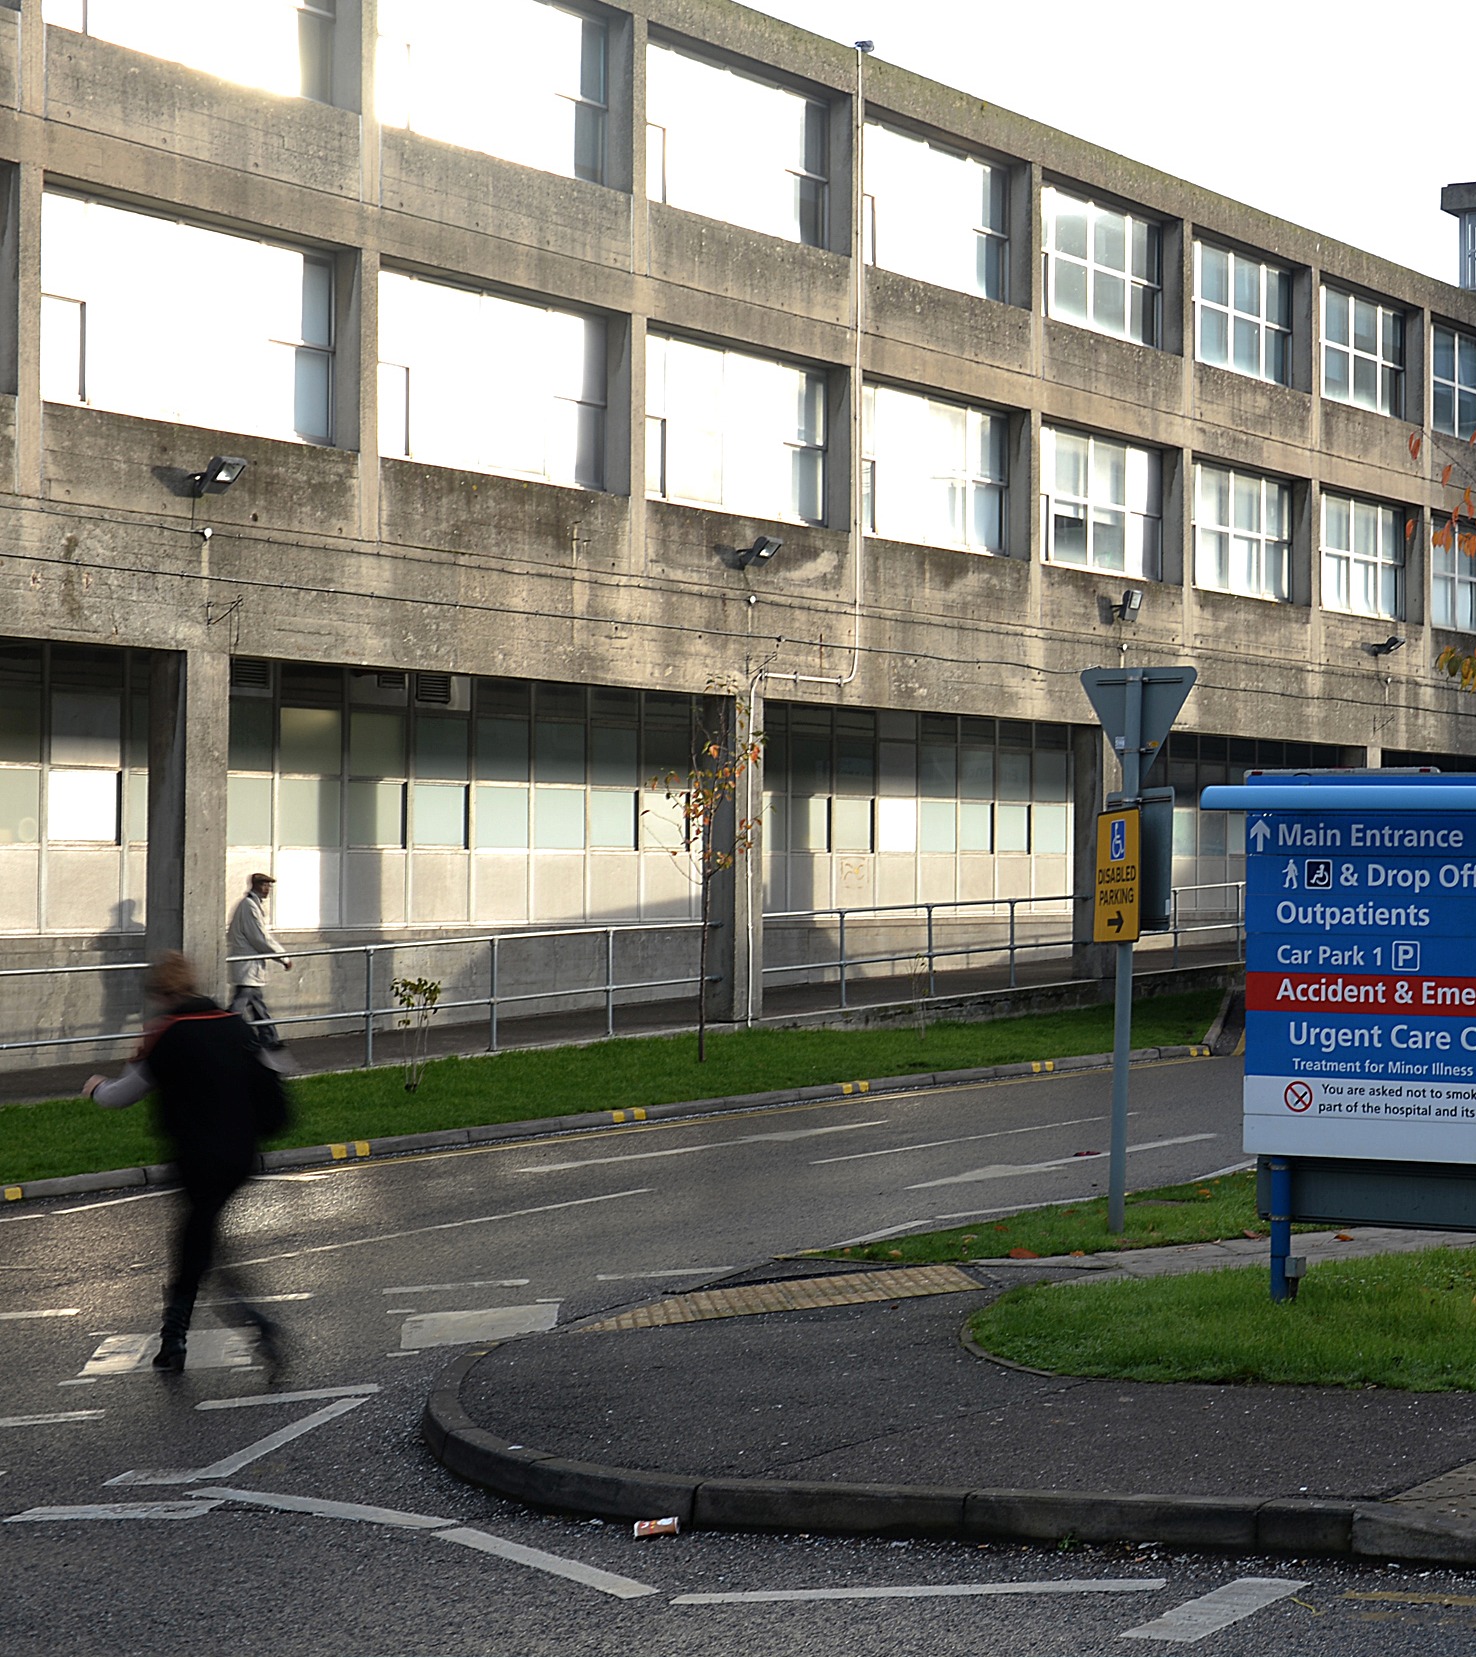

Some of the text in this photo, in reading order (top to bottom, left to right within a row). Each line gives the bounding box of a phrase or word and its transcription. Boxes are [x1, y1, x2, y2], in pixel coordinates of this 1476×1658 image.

[1279, 823, 1463, 847] Main Entrance
[1098, 865, 1136, 885] DISABLED
[1340, 864, 1358, 886] &
[1368, 864, 1430, 893] Drop
[1099, 888, 1134, 906] PARKING
[1277, 901, 1429, 930] Outpatients
[1277, 945, 1312, 964] Car
[1319, 945, 1364, 965] Park
[1373, 947, 1381, 965] 1
[1276, 978, 1386, 1003] Accident
[1395, 981, 1412, 1003] &
[1290, 1022, 1382, 1052] Urgent
[1391, 1025, 1450, 1049] Care
[1293, 1058, 1360, 1072] Treatment
[1365, 1060, 1384, 1072] for
[1388, 1061, 1428, 1074] Minor
[1432, 1063, 1473, 1076] Illness
[1322, 1084, 1342, 1094] You
[1347, 1087, 1365, 1095] are
[1369, 1086, 1401, 1098] asked
[1406, 1087, 1425, 1098] not
[1430, 1089, 1442, 1098] to
[1319, 1103, 1342, 1114] part
[1346, 1102, 1358, 1112] of
[1362, 1102, 1380, 1114] the
[1385, 1103, 1431, 1119] hospital
[1435, 1107, 1457, 1118] and
[1462, 1106, 1475, 1118] its
